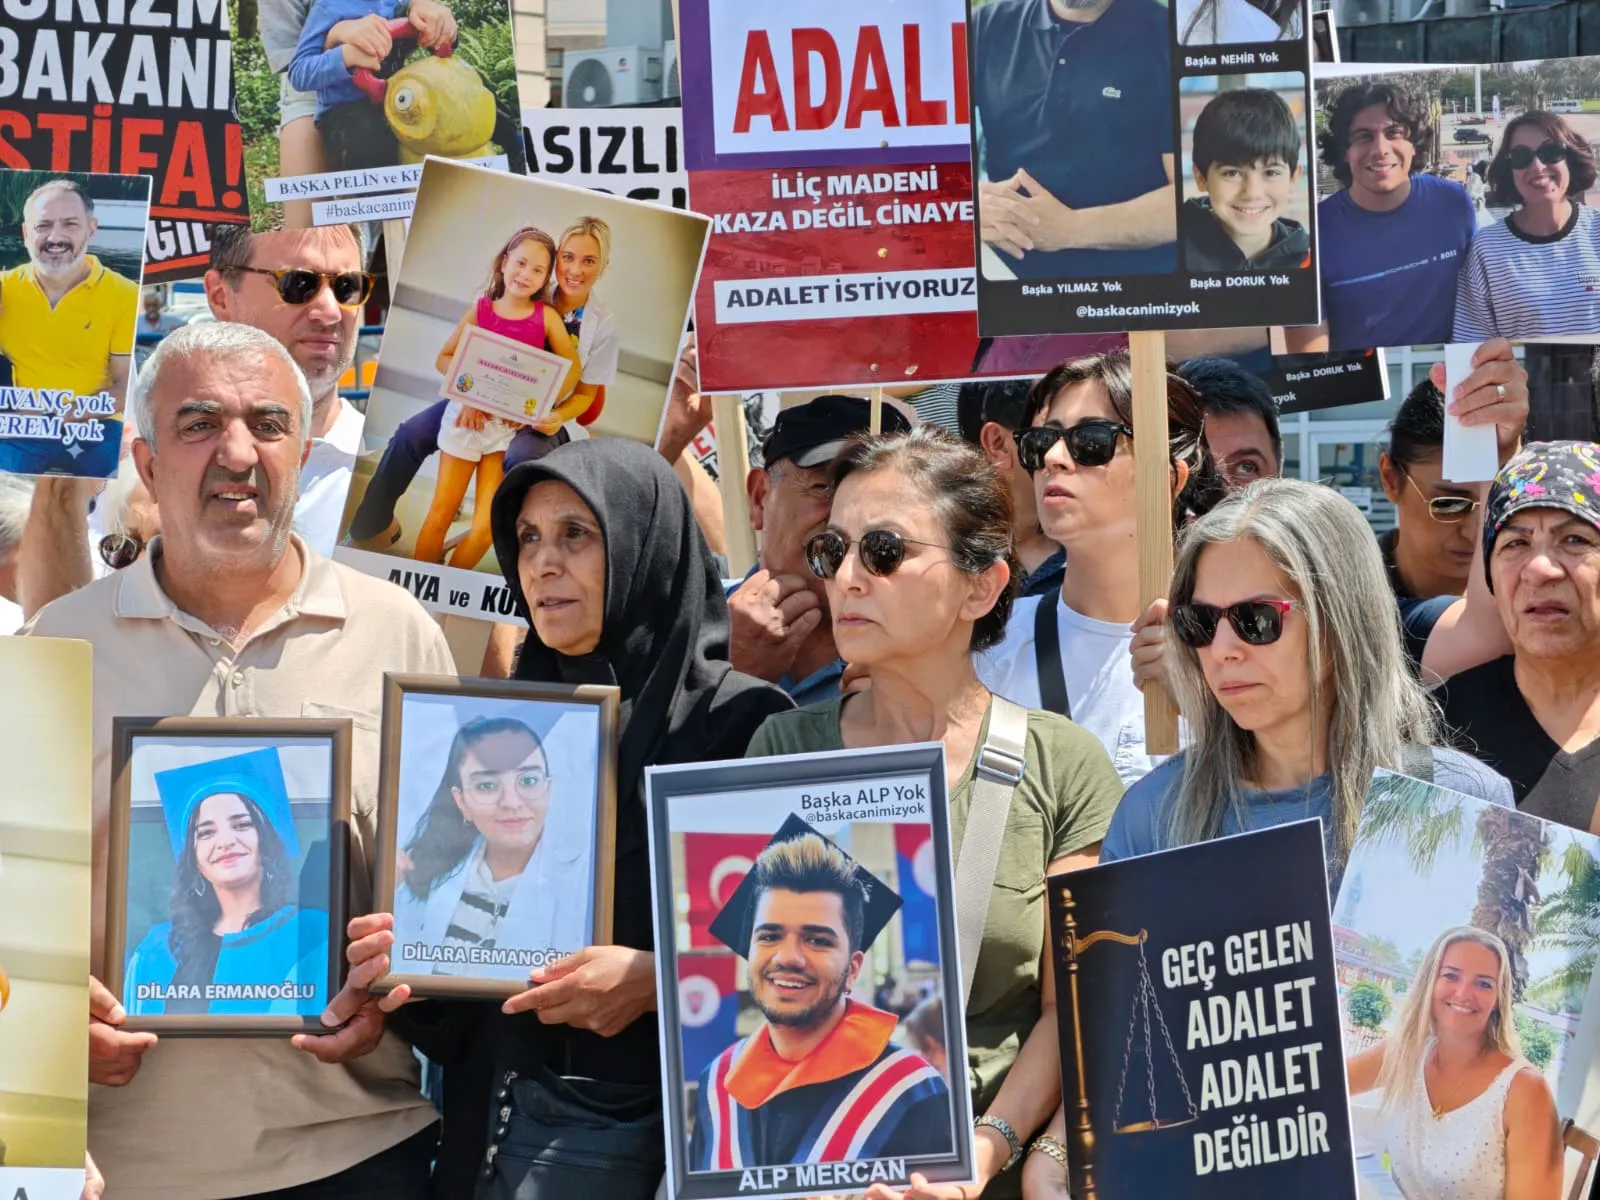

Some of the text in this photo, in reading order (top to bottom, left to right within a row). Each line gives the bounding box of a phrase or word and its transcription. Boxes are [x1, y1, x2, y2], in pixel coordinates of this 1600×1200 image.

[0, 26, 232, 110] BAKANI
[1184, 51, 1280, 68] Başka NEHİR Yok
[279, 179, 330, 199] BAŞKA
[334, 171, 379, 191] PELİN
[383, 175, 397, 184] ve
[772, 165, 938, 204] İLİÇ MADENİ
[713, 210, 787, 234] KAZA
[792, 200, 872, 230] DEĞİL
[727, 277, 976, 309] ADALET İSTİYORUZ
[1021, 281, 1122, 297] Başka YILMAZ Yok
[1190, 274, 1290, 290] Başka DORUK Yok
[1076, 301, 1200, 317] @baskacanimizyok
[1313, 365, 1345, 377] DORUK
[75, 393, 114, 418] yok
[62, 419, 104, 444] yok
[448, 589, 471, 608] ve
[801, 784, 926, 811] Başka ALP Yok
[805, 802, 925, 825] @baskacanimizyok
[402, 942, 466, 964] DİLARA
[1161, 920, 1314, 991] GEÇ GELEN
[137, 982, 315, 999] DİLARA ERMANOĞLU
[1186, 976, 1316, 1051] ADALET
[1200, 1041, 1323, 1112] ADALET
[1193, 1105, 1330, 1176] DEĞİLDİR
[738, 1159, 906, 1191] ALP MERCAN
